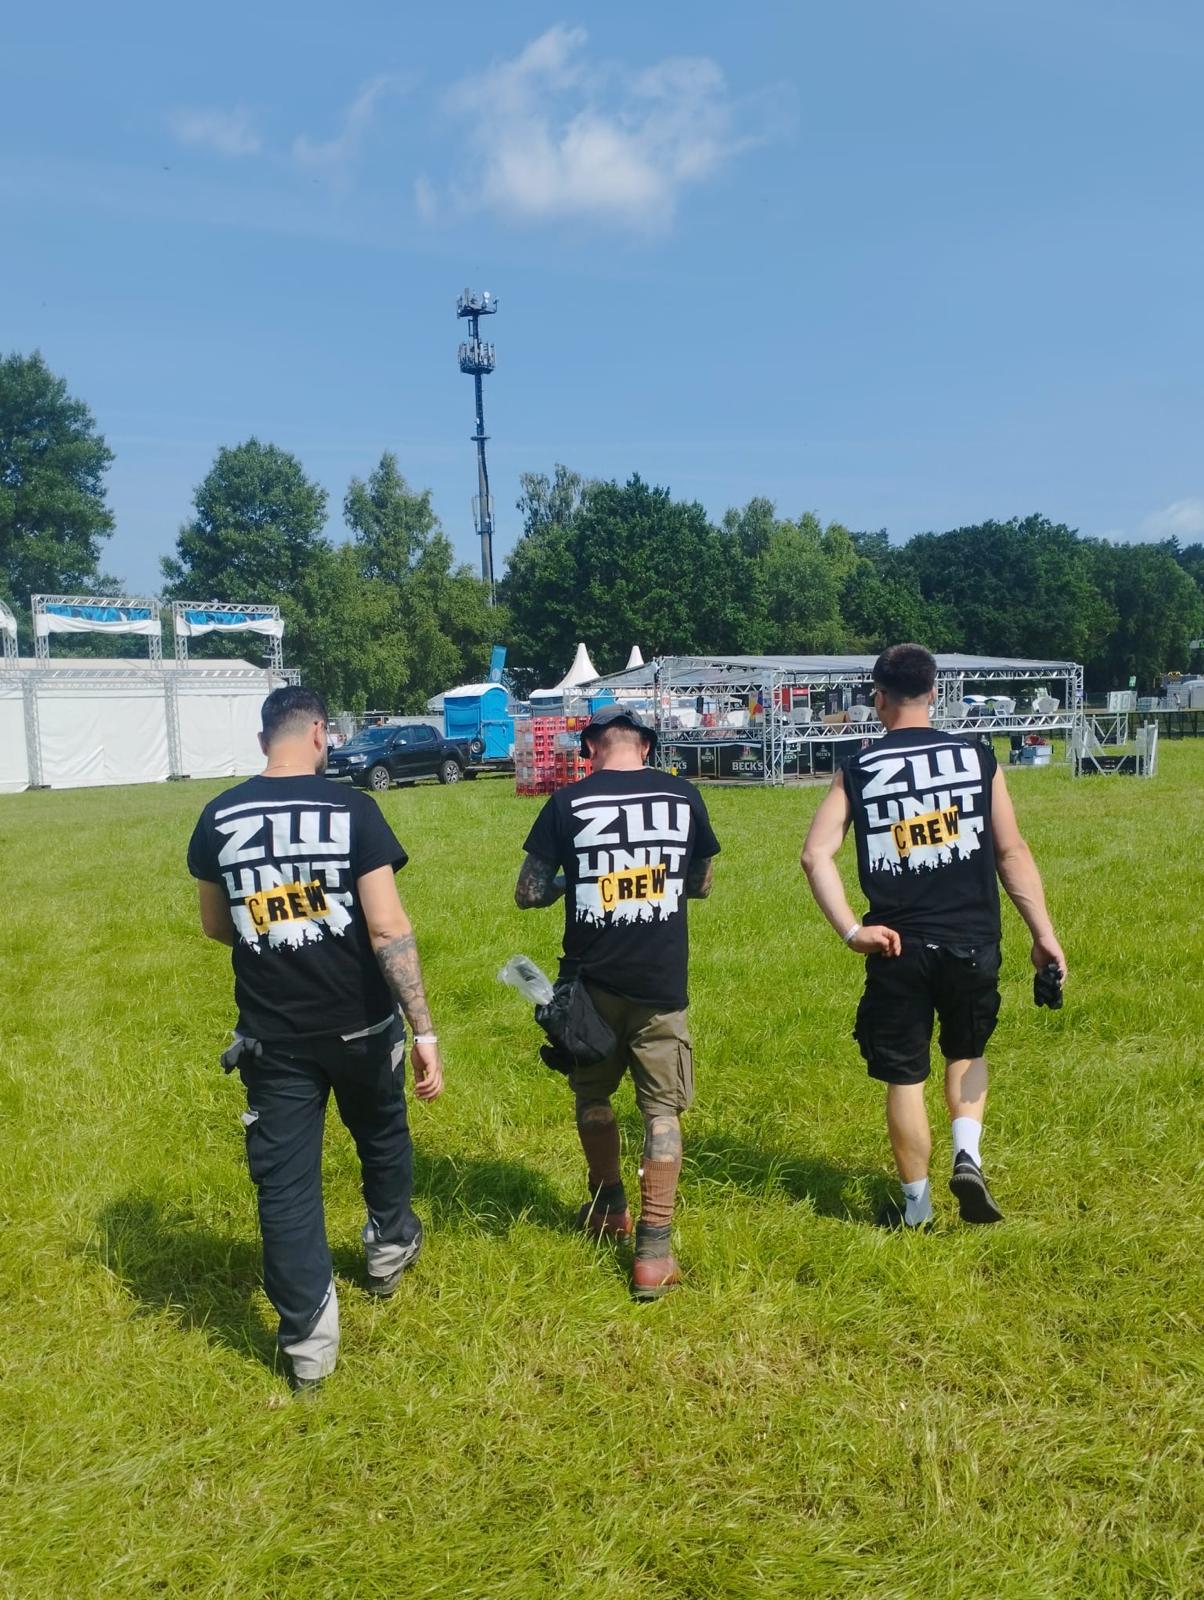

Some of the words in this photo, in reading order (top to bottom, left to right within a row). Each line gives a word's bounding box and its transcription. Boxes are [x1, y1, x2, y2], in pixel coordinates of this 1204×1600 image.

[732, 760, 764, 771] BECK'S
[893, 810, 960, 850] CREW
[601, 868, 667, 903] CREW
[248, 885, 327, 931] CREW
